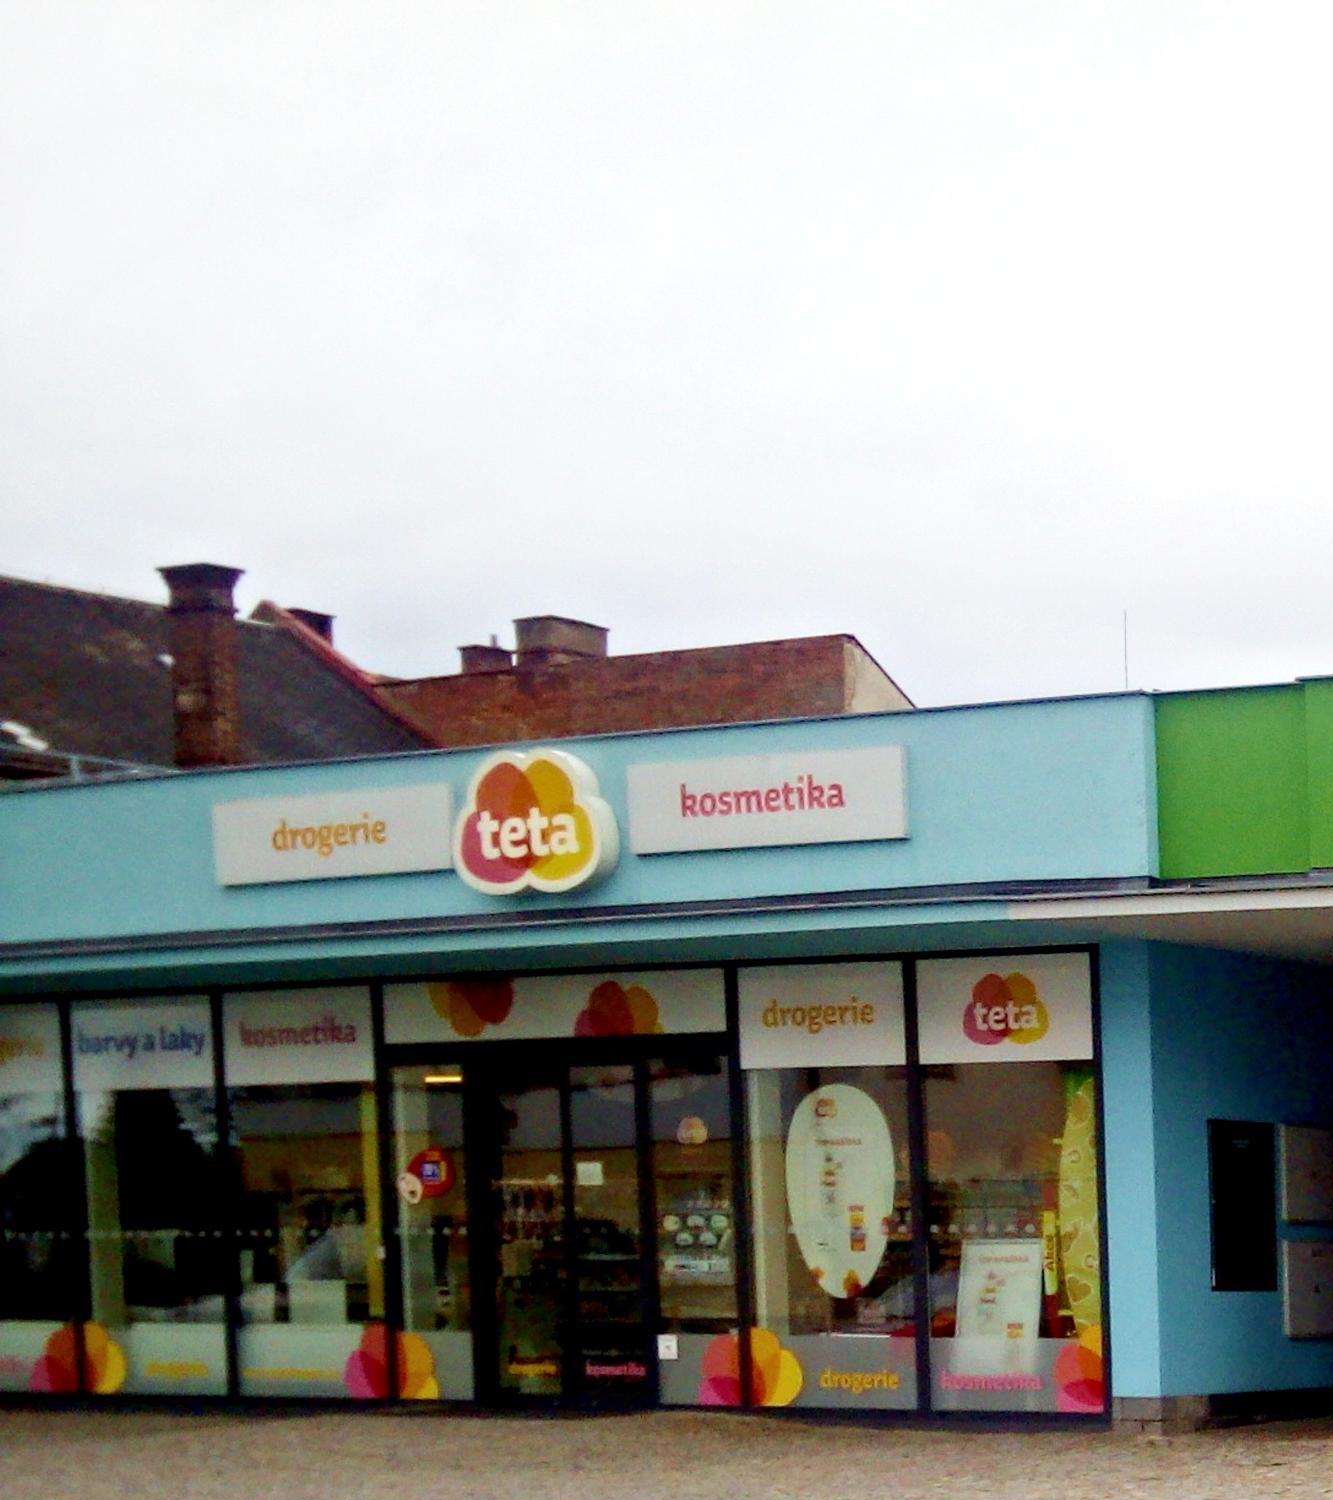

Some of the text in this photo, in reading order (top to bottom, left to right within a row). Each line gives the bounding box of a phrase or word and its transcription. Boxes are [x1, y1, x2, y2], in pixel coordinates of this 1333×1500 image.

[679, 774, 846, 818] kosmetika
[272, 812, 387, 856] drogerie
[476, 806, 579, 861] teta
[239, 1013, 357, 1048] kosmetika
[762, 996, 875, 1034] drogerie
[973, 999, 1039, 1032] teta
[820, 1369, 899, 1393] drogerie
